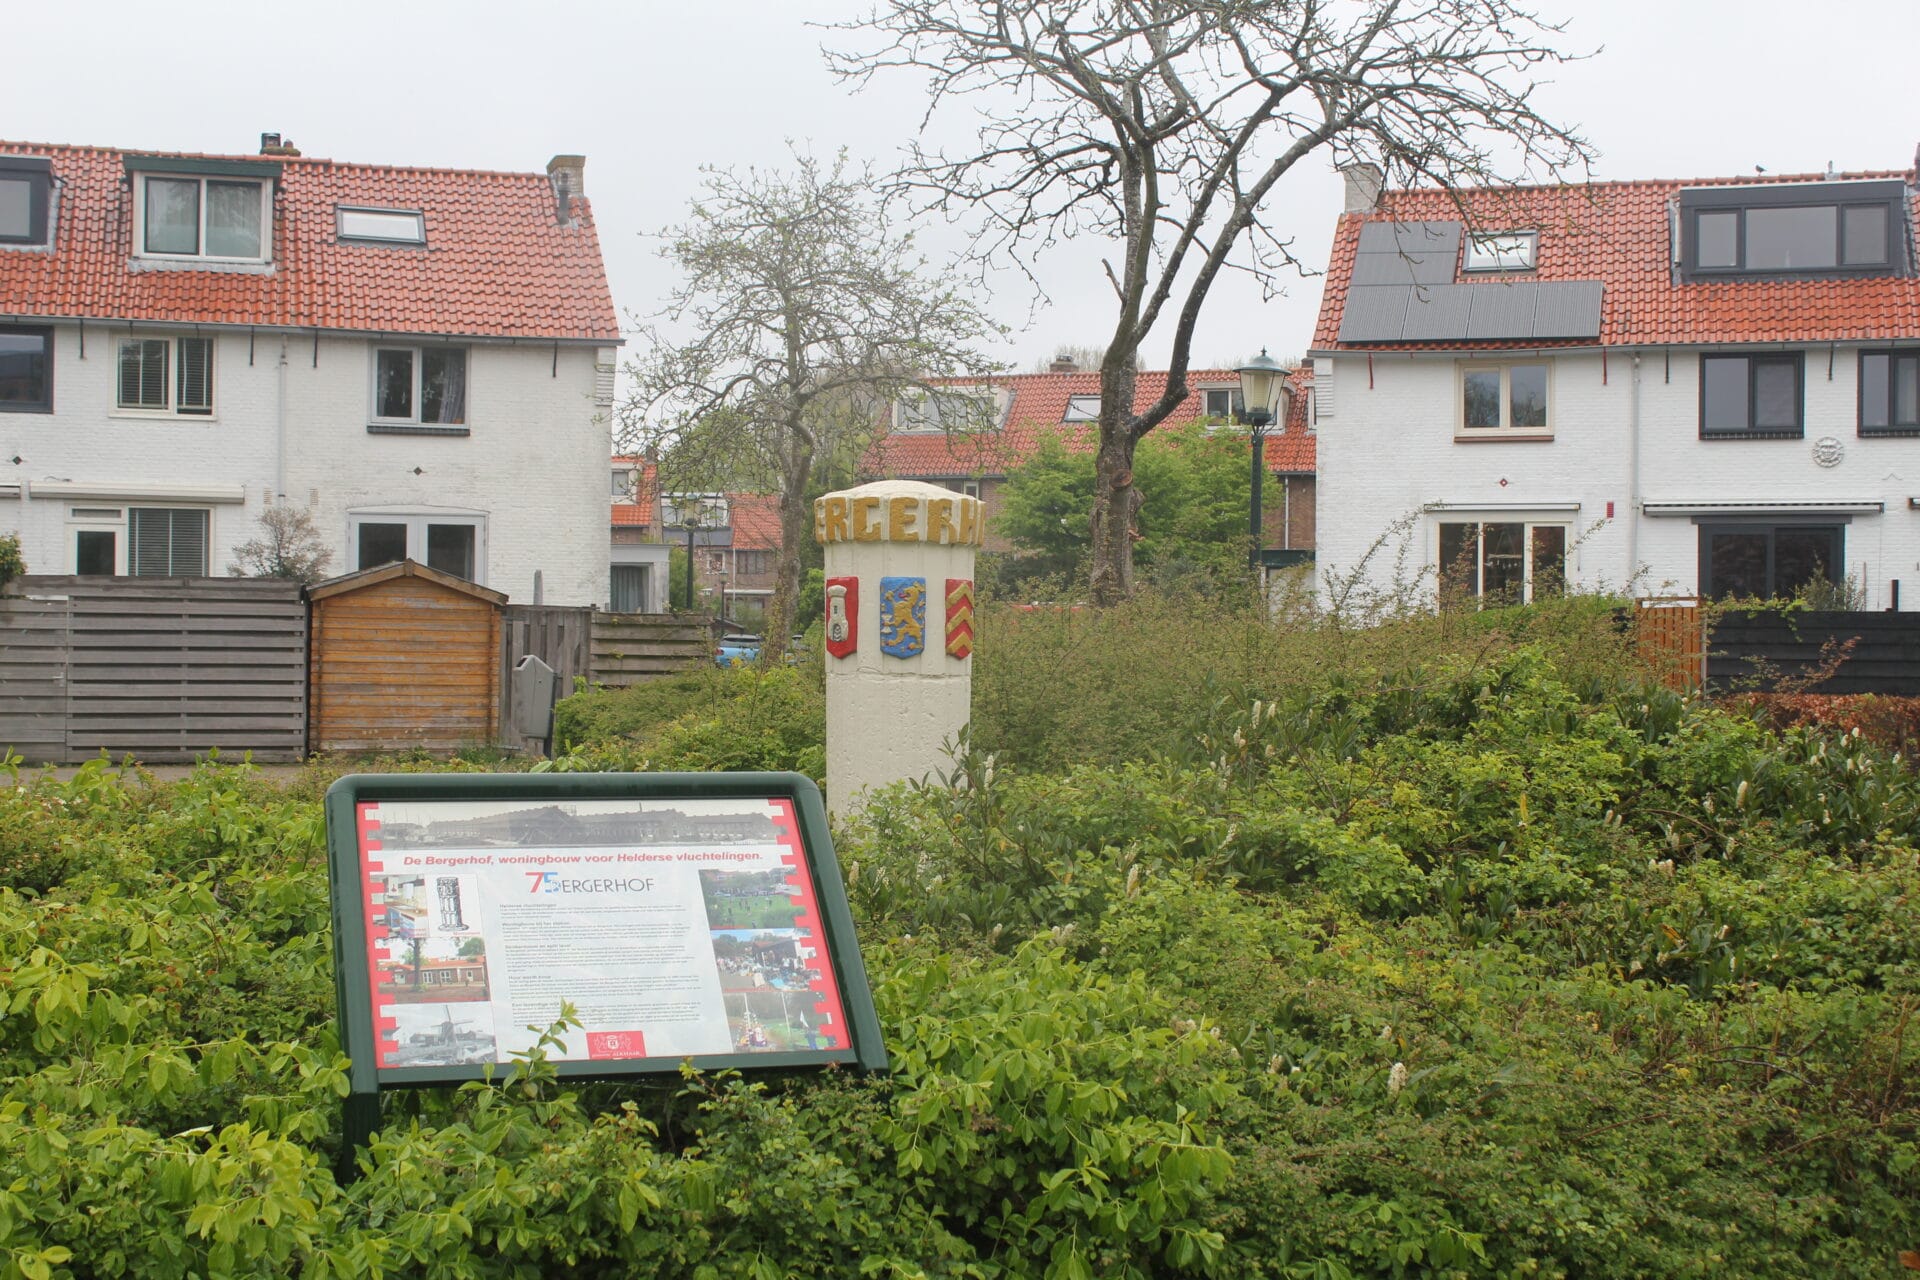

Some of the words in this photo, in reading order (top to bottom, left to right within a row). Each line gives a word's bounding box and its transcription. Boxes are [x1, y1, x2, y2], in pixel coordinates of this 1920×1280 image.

[403, 856, 421, 865] De
[425, 855, 494, 867] Bergerhof,
[498, 855, 580, 866] woningbouw
[584, 854, 613, 863] voor
[617, 853, 672, 862] Helderse
[676, 852, 763, 862] vluchtelingen.
